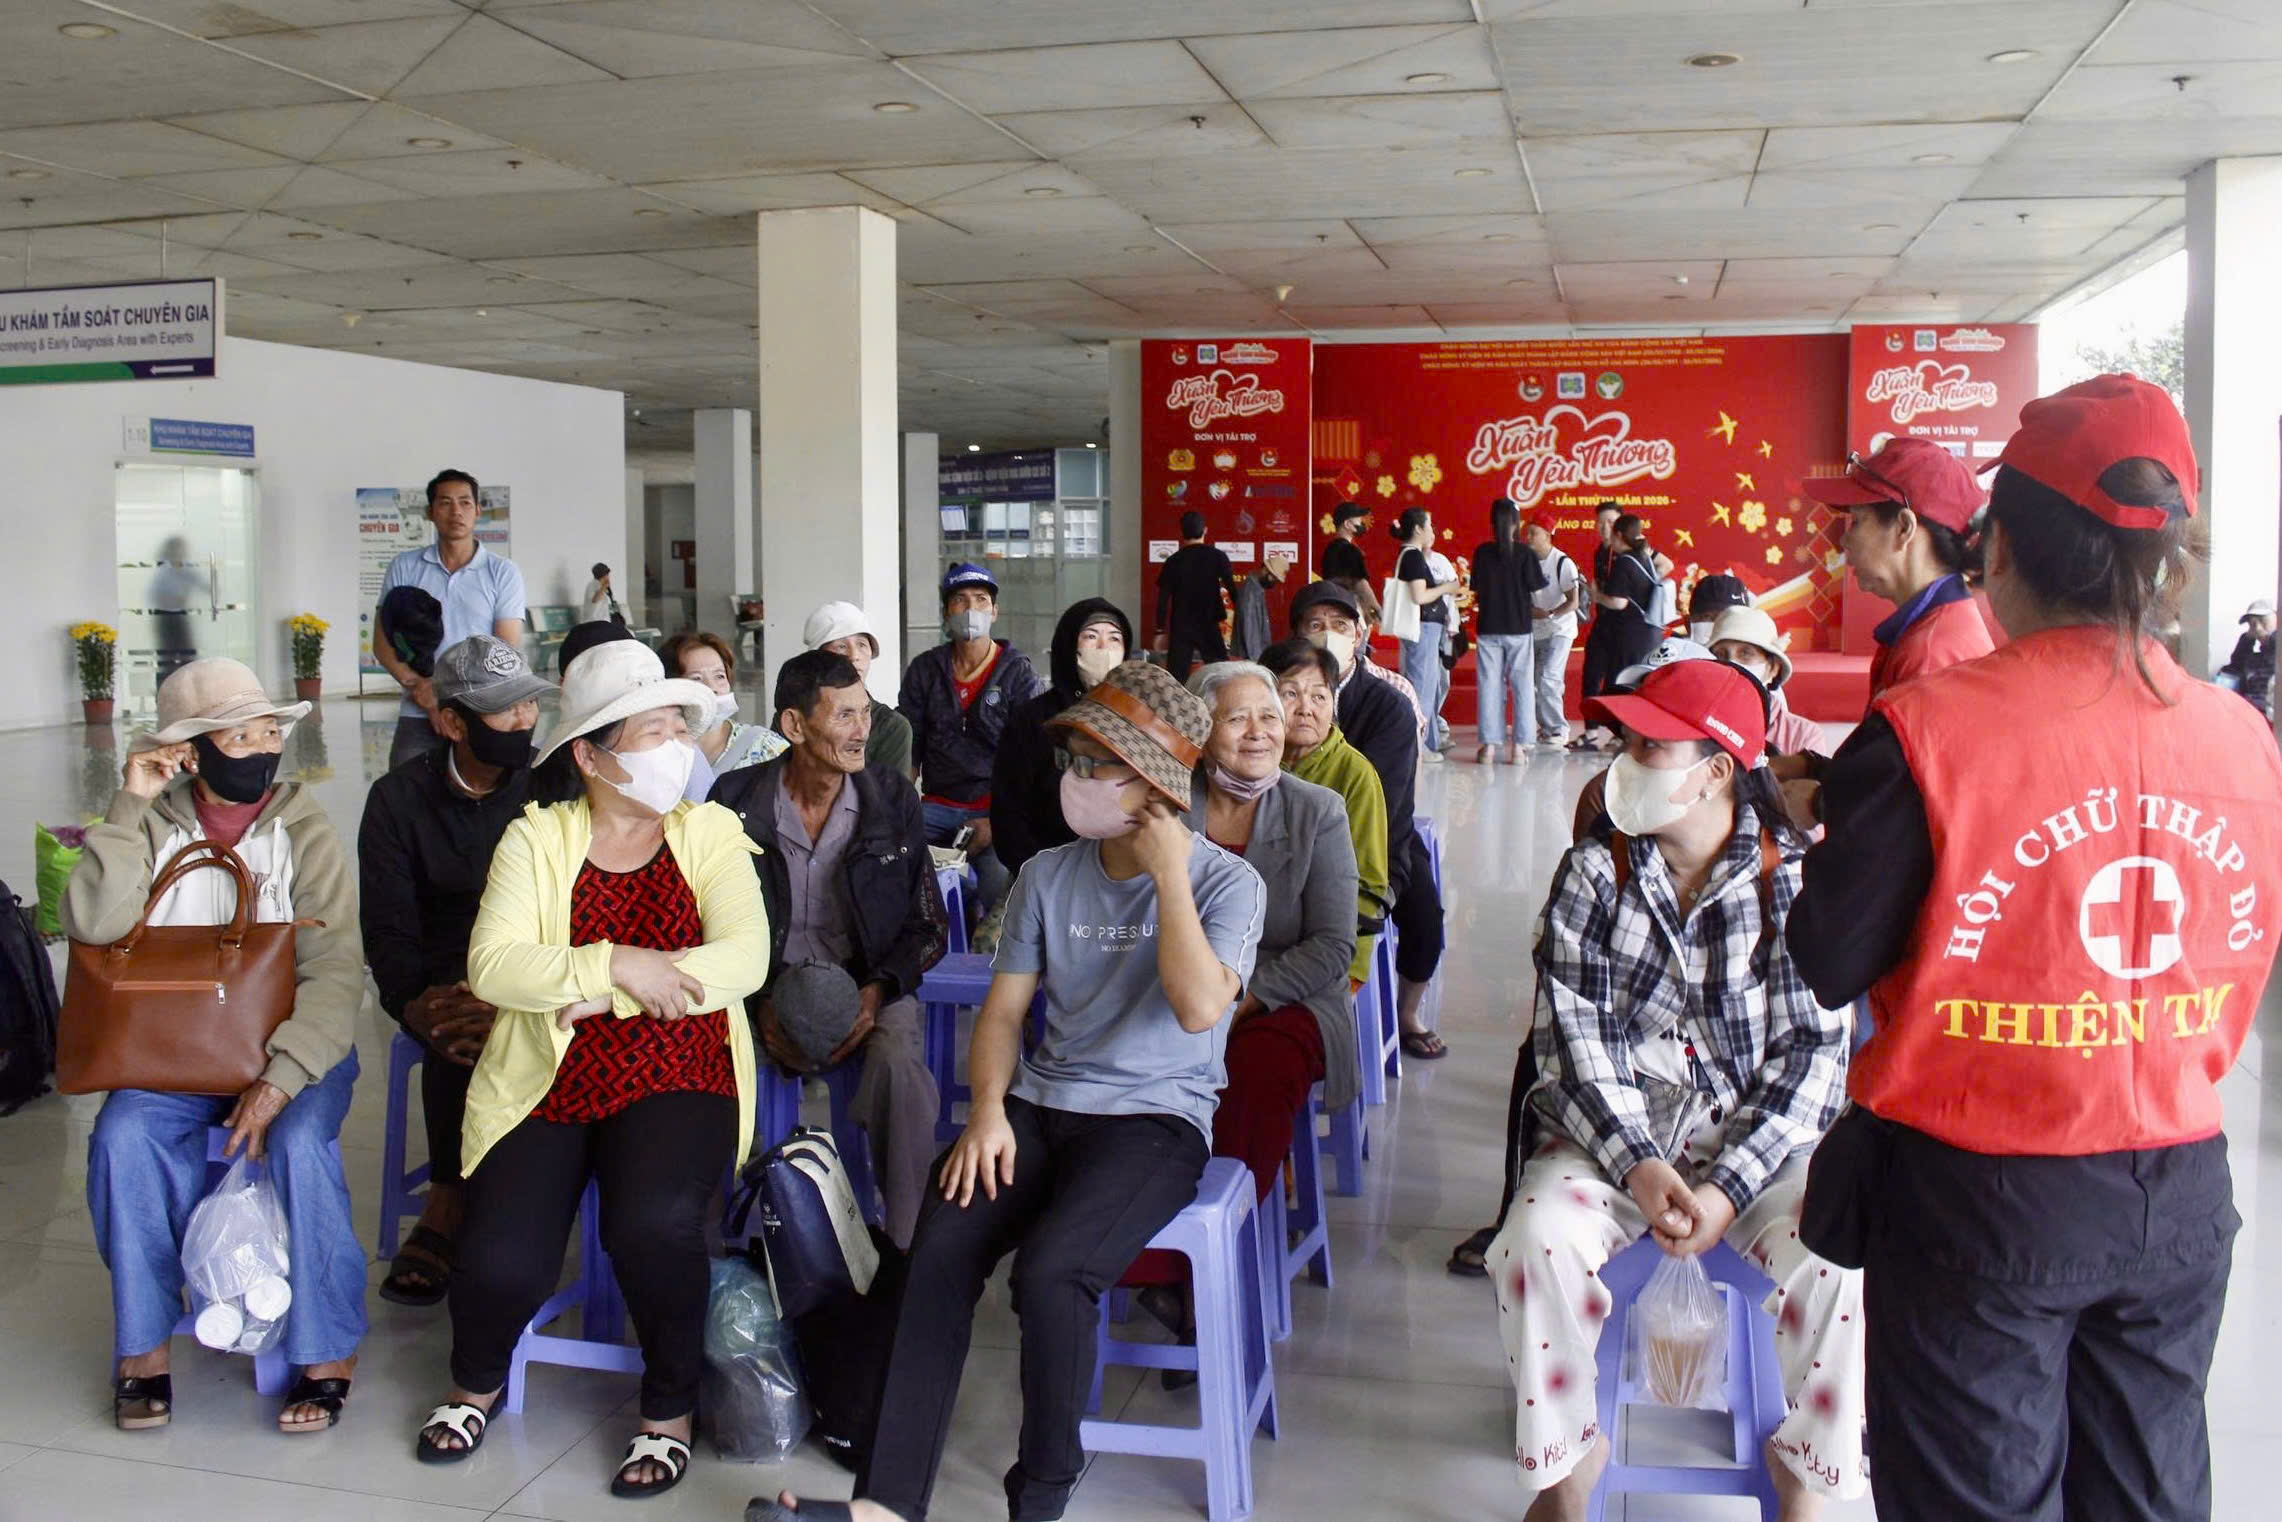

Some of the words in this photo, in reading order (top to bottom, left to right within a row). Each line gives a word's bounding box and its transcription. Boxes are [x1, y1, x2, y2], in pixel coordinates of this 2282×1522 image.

[10, 308, 48, 331] KHÁM
[84, 304, 120, 328] SOÁT
[124, 301, 181, 325] CHUYÊN
[185, 304, 209, 322] GIA
[0, 341, 36, 354] creening
[117, 334, 137, 346] Area
[140, 332, 158, 345] with
[160, 331, 193, 347] Experts
[1466, 415, 1560, 475] Xuân
[1506, 451, 1579, 509] Yêu
[1572, 435, 1676, 486] Thương
[1616, 494, 1641, 506] NĂM
[1643, 495, 1669, 506] 2026
[1555, 518, 1580, 529] ÁNG
[1581, 520, 1596, 529] 02
[1943, 869, 2015, 963] HỘI
[2014, 787, 2119, 867] CHỮ
[2137, 794, 2246, 874] THẬP
[2227, 881, 2264, 951] ĐỎ
[1069, 923, 1091, 938] NO
[1934, 989, 2149, 1060] THIỆN
